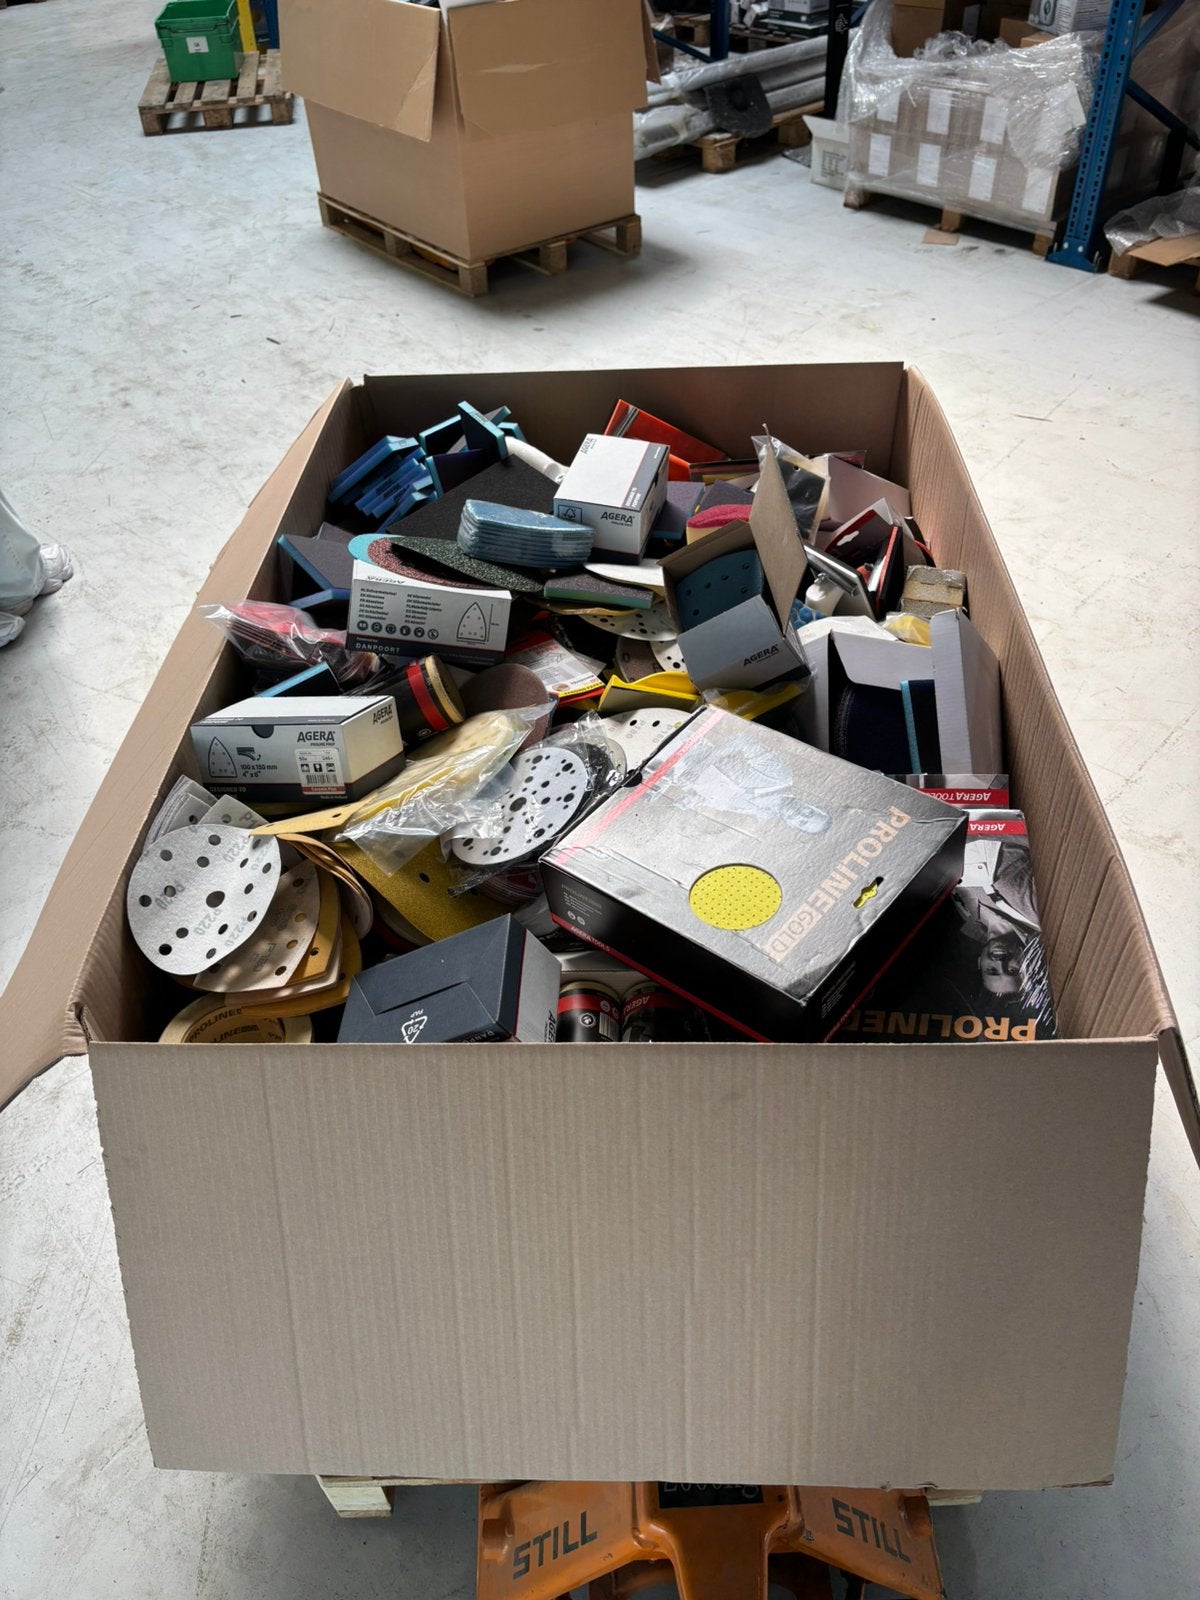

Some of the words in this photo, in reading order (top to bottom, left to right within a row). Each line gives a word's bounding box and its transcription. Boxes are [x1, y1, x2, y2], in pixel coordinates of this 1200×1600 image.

[601, 511, 635, 524] AGERA
[355, 642, 400, 653] DANPOORT
[744, 645, 779, 666] AGERA
[372, 703, 393, 726] AGERA
[297, 731, 335, 743] AGERA
[970, 823, 1006, 831] AGERA
[407, 1023, 420, 1035] 20
[832, 1497, 911, 1563] STILL
[512, 1510, 597, 1580] STILL
